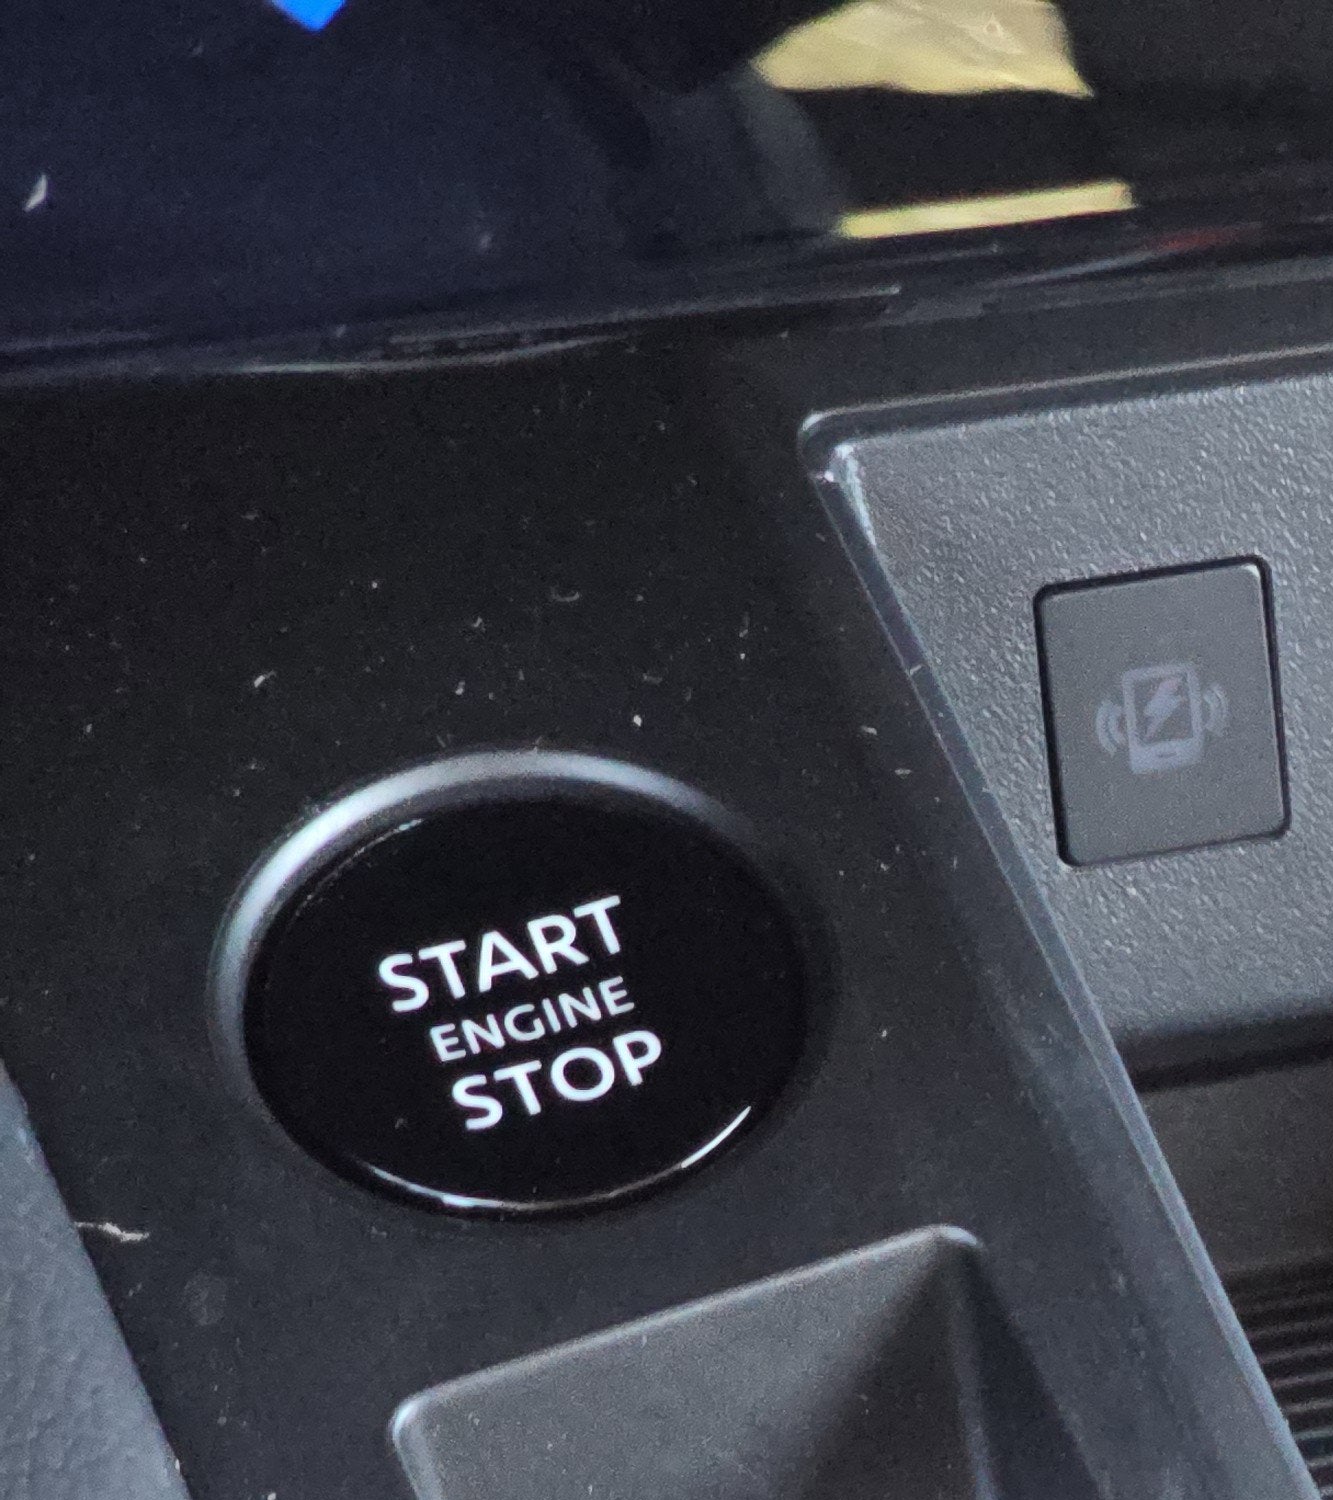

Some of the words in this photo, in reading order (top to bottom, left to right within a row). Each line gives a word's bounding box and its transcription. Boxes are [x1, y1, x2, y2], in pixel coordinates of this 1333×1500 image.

[378, 895, 622, 1013] START
[429, 976, 635, 1062] ENGINE
[451, 1029, 663, 1130] STOP
